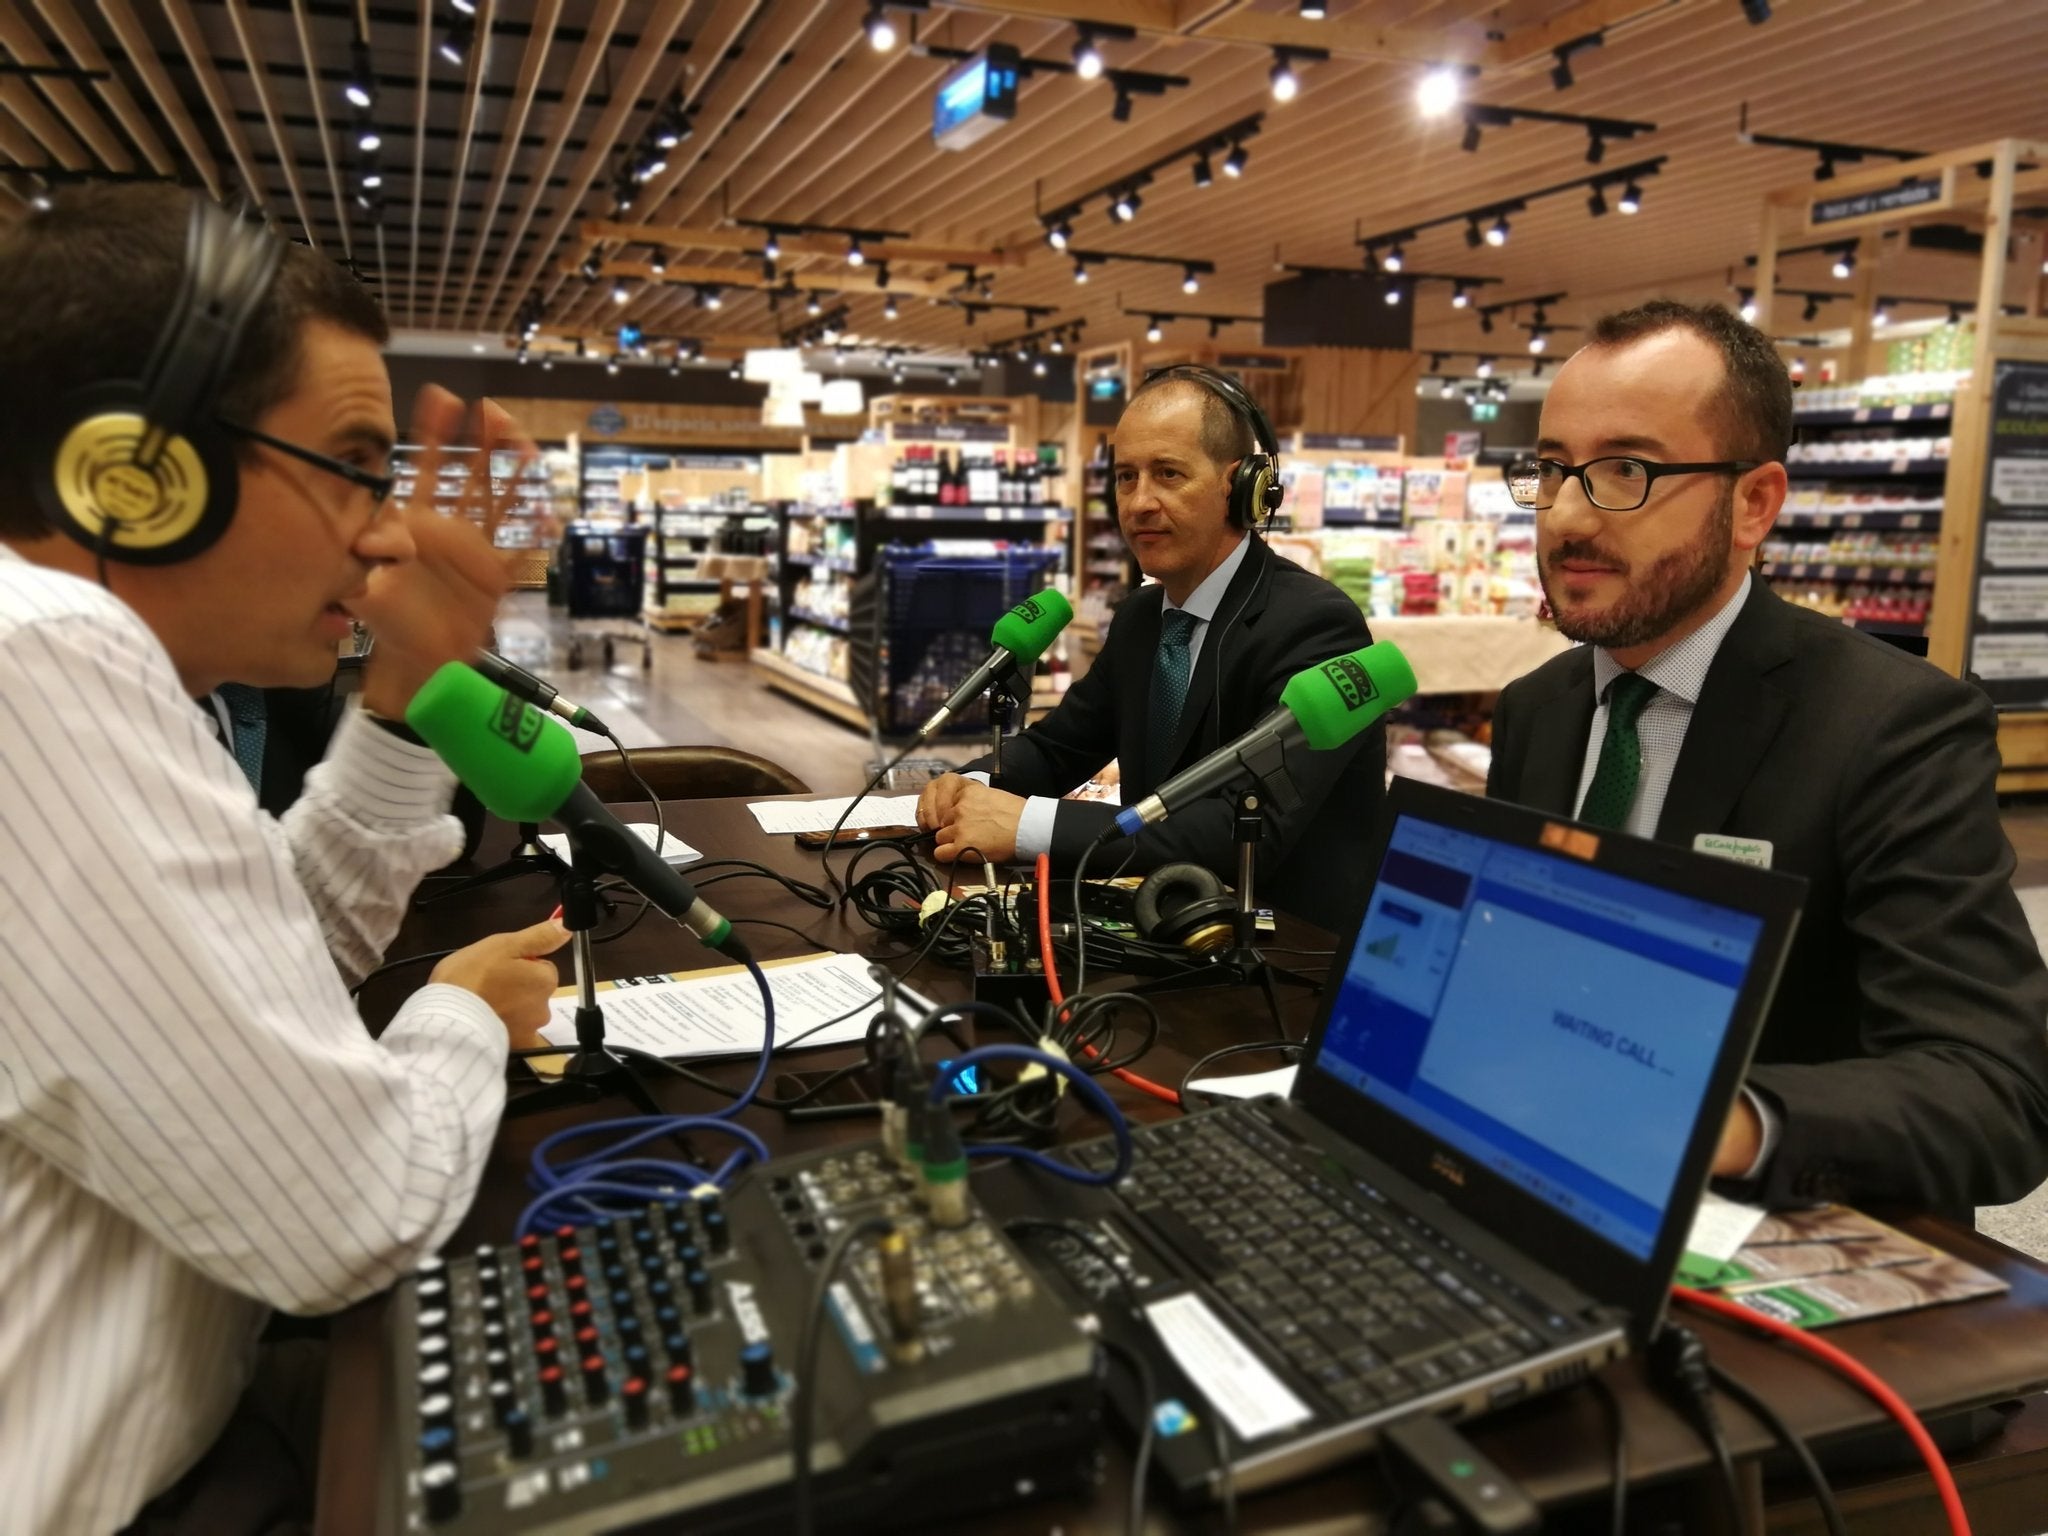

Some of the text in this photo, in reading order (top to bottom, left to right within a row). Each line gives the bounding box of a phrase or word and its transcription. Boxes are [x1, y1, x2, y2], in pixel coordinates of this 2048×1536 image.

[1331, 667, 1358, 700] CERO
[1343, 660, 1369, 693] ONDA
[1553, 1010, 1614, 1048] WAITING
[1616, 1036, 1656, 1069] CALL
